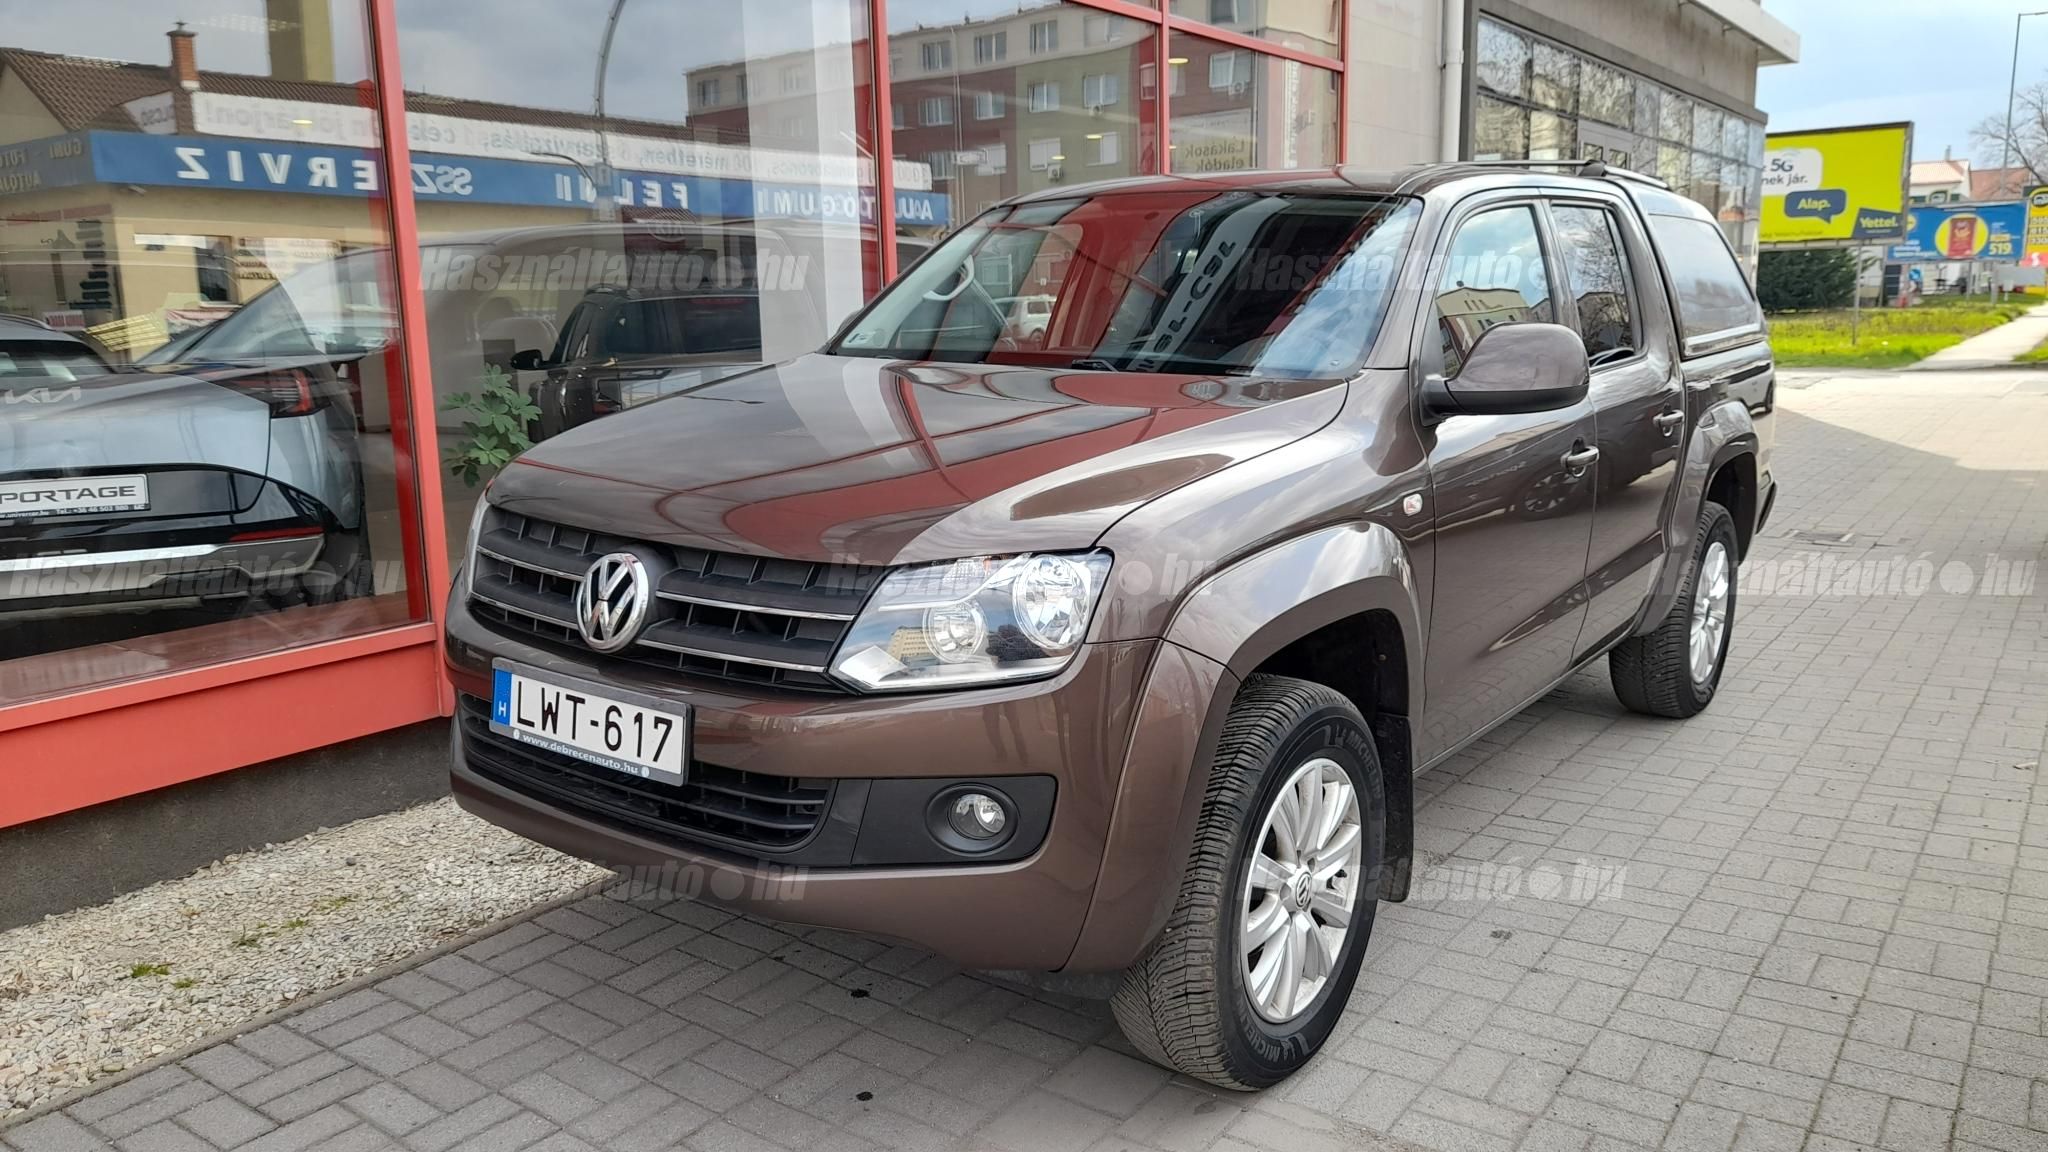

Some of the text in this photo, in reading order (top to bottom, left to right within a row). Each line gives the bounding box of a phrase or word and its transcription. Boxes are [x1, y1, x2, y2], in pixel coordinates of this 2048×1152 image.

[1771, 158, 1793, 172] 5G
[1761, 174, 1785, 186] nek
[1797, 198, 1832, 211] Alap.
[1859, 216, 1899, 228] Yettel.
[0, 486, 137, 505] PORTAGE
[498, 701, 507, 718] H
[516, 680, 673, 762] LWT-617
[522, 734, 639, 775] www.debrecenauto.hu
